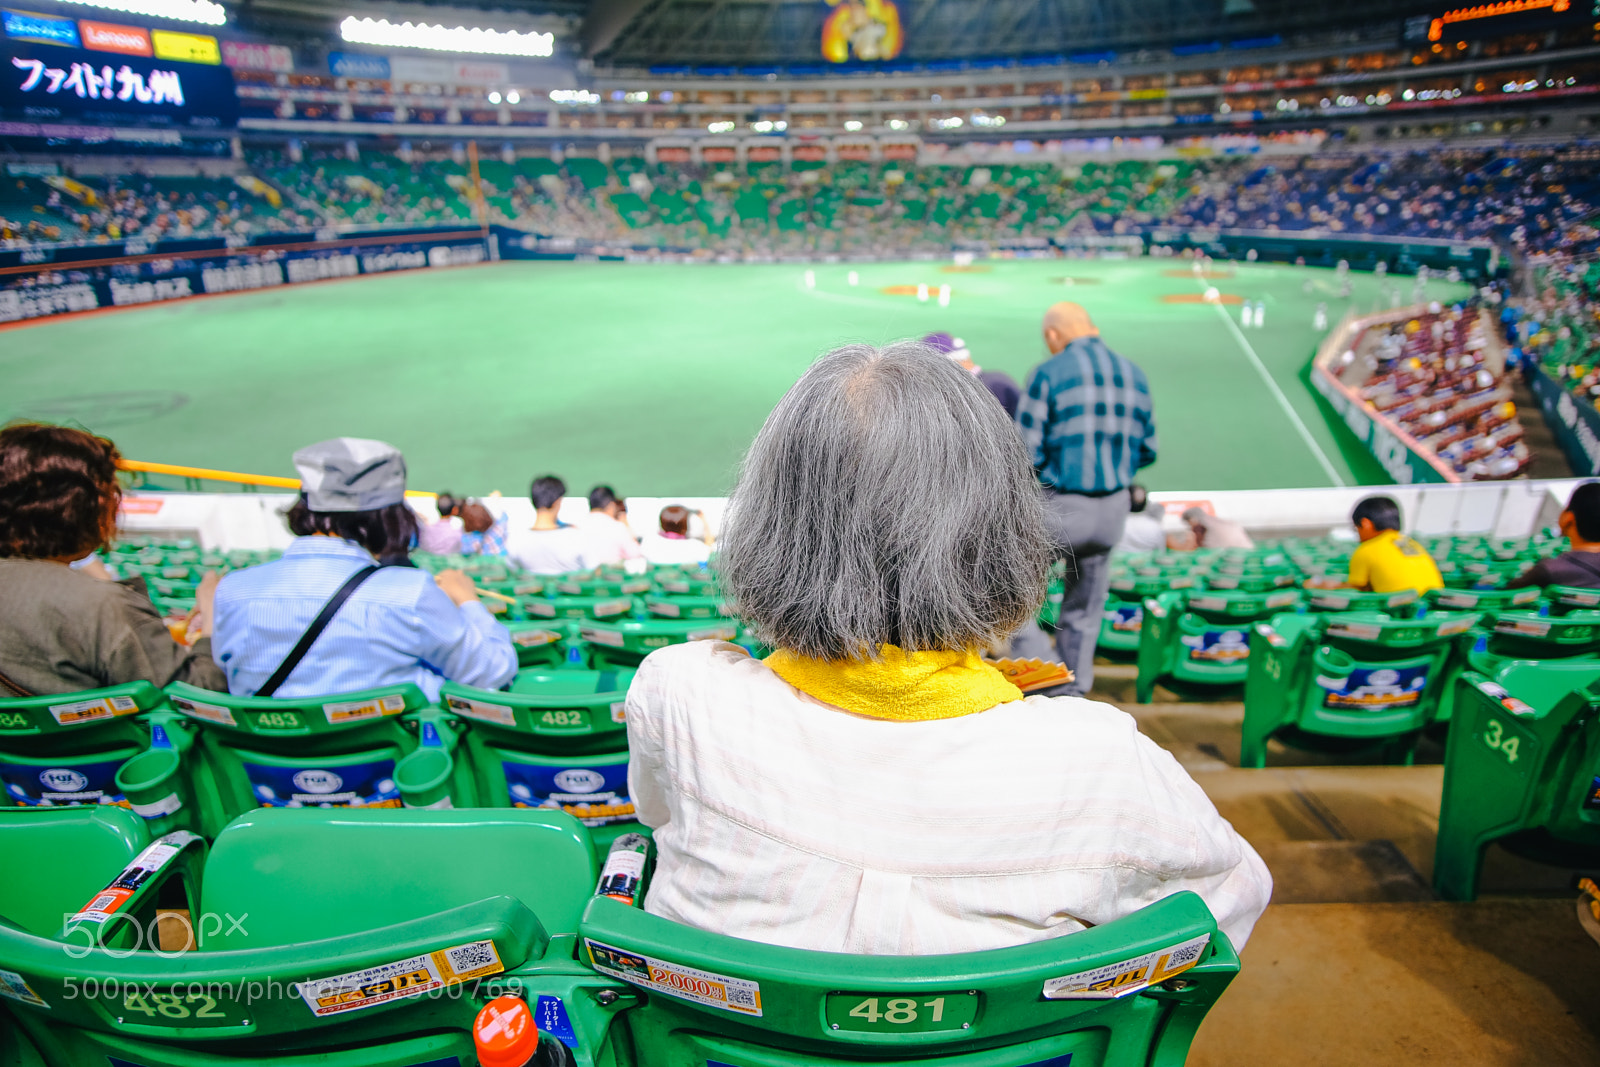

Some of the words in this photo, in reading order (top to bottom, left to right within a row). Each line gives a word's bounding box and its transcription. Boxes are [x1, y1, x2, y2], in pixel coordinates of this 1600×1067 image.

[85, 26, 147, 49] Lenovo
[12, 56, 185, 106] ファイト!九州
[258, 712, 298, 727] 483
[541, 710, 582, 725] 482
[1483, 718, 1521, 764] 34
[124, 992, 227, 1019] 482
[543, 1001, 552, 1031] サーバーなら
[551, 1001, 559, 1026] ウォーター
[849, 997, 945, 1024] 481
